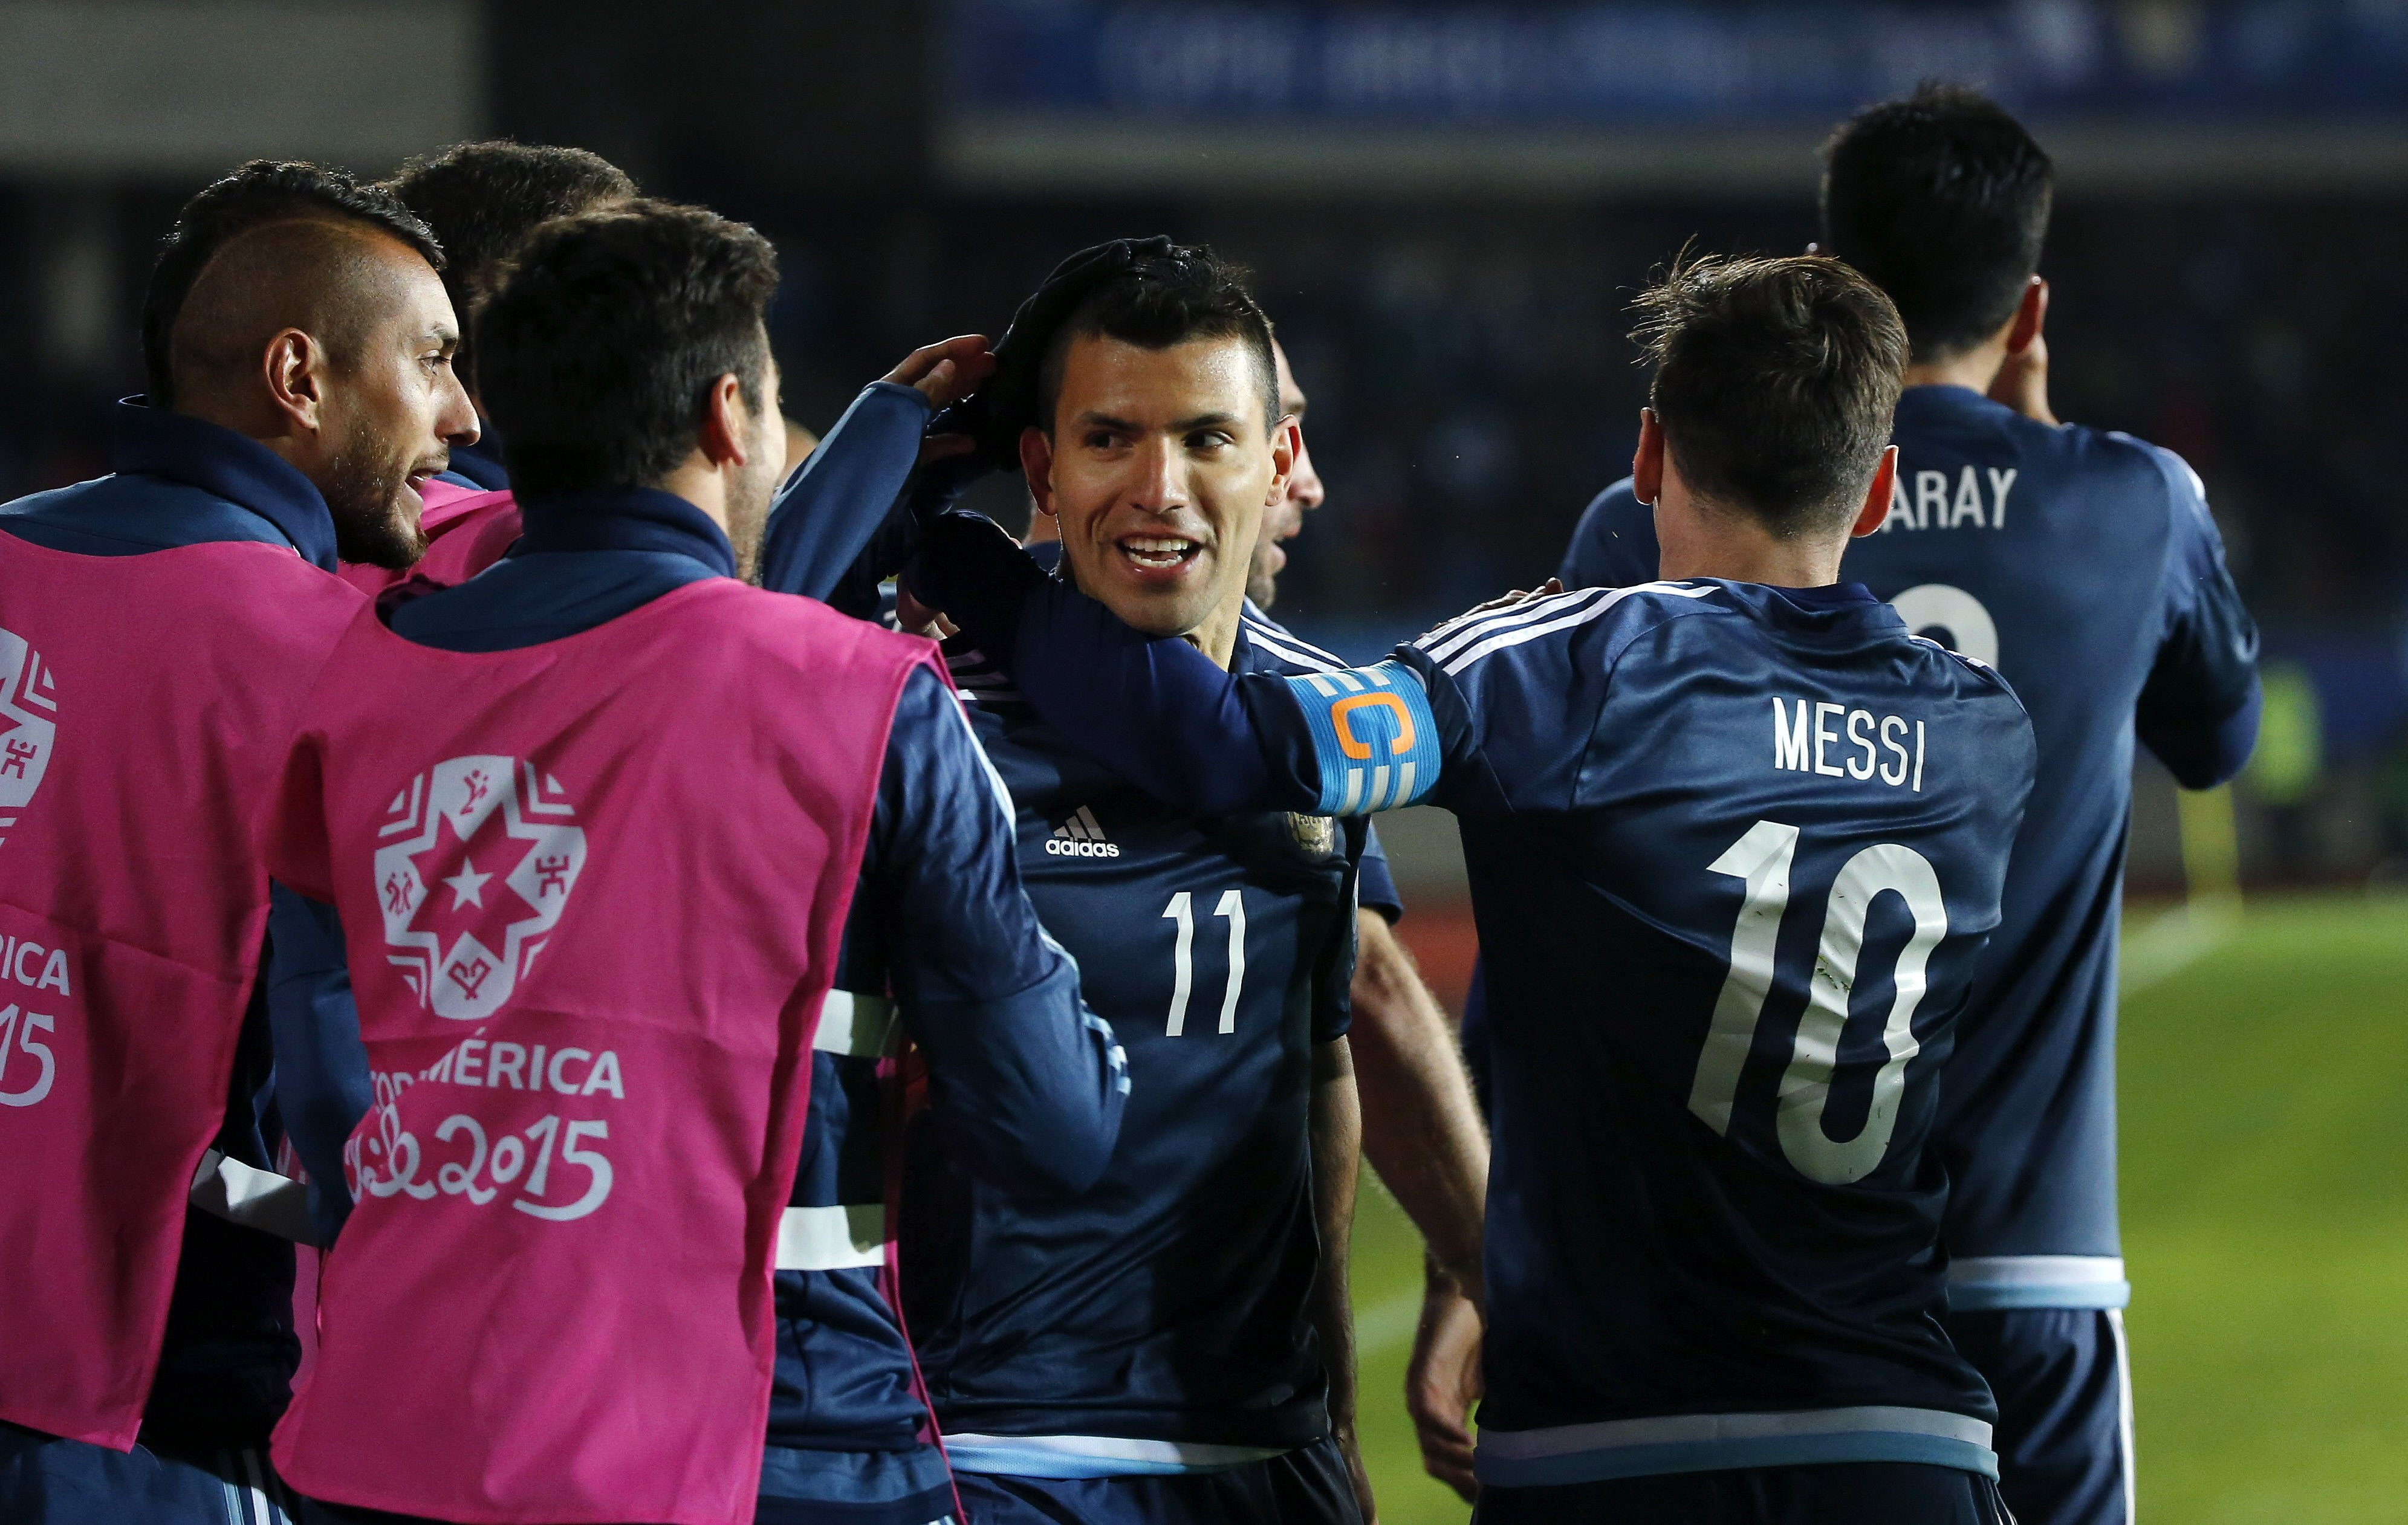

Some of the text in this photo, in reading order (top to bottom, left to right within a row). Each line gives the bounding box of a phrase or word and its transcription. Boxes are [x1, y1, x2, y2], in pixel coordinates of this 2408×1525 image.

[1772, 697, 1925, 792] MESSI
[1045, 838, 1120, 857] adidas
[1161, 890, 1245, 1036] 11
[1687, 820, 1948, 1185] 10
[435, 1114, 614, 1221] 2015
